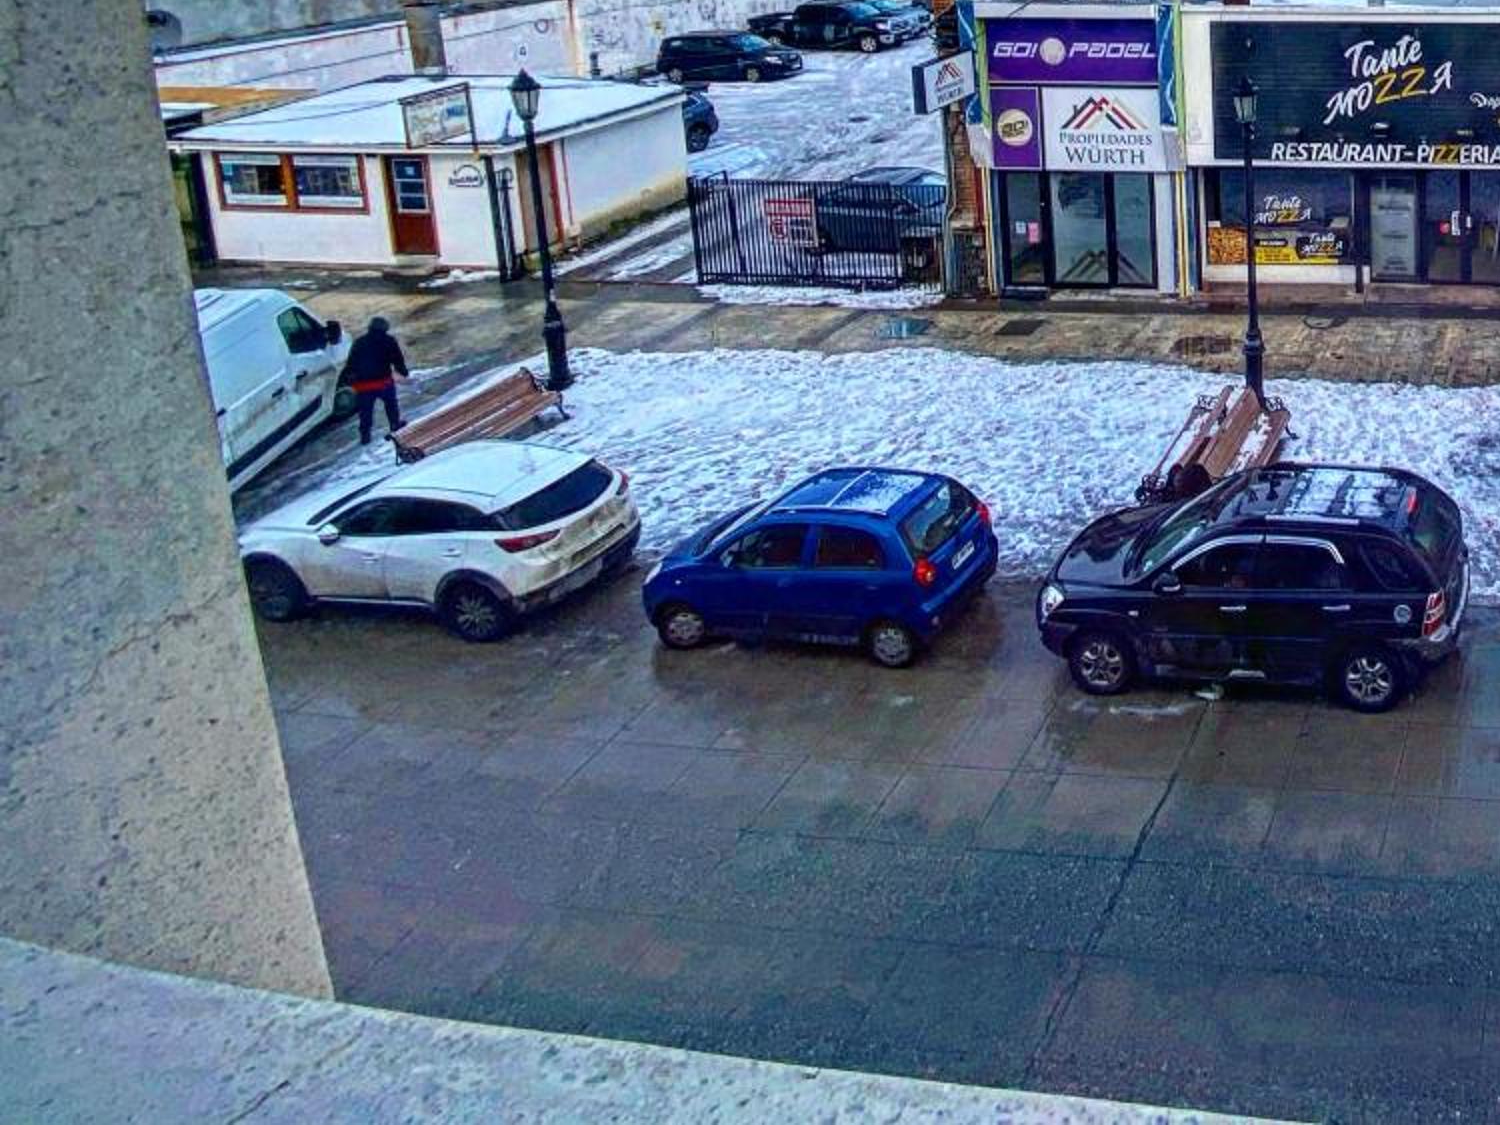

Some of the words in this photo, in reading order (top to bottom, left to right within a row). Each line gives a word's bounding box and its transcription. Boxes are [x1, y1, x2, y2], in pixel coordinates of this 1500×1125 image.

[993, 42, 1039, 58] GO!
[1344, 34, 1423, 78] Tante
[1323, 61, 1453, 125] MOZZA
[1059, 131, 1153, 146] PROPIEDADES
[1065, 145, 1145, 165] WÜRTH
